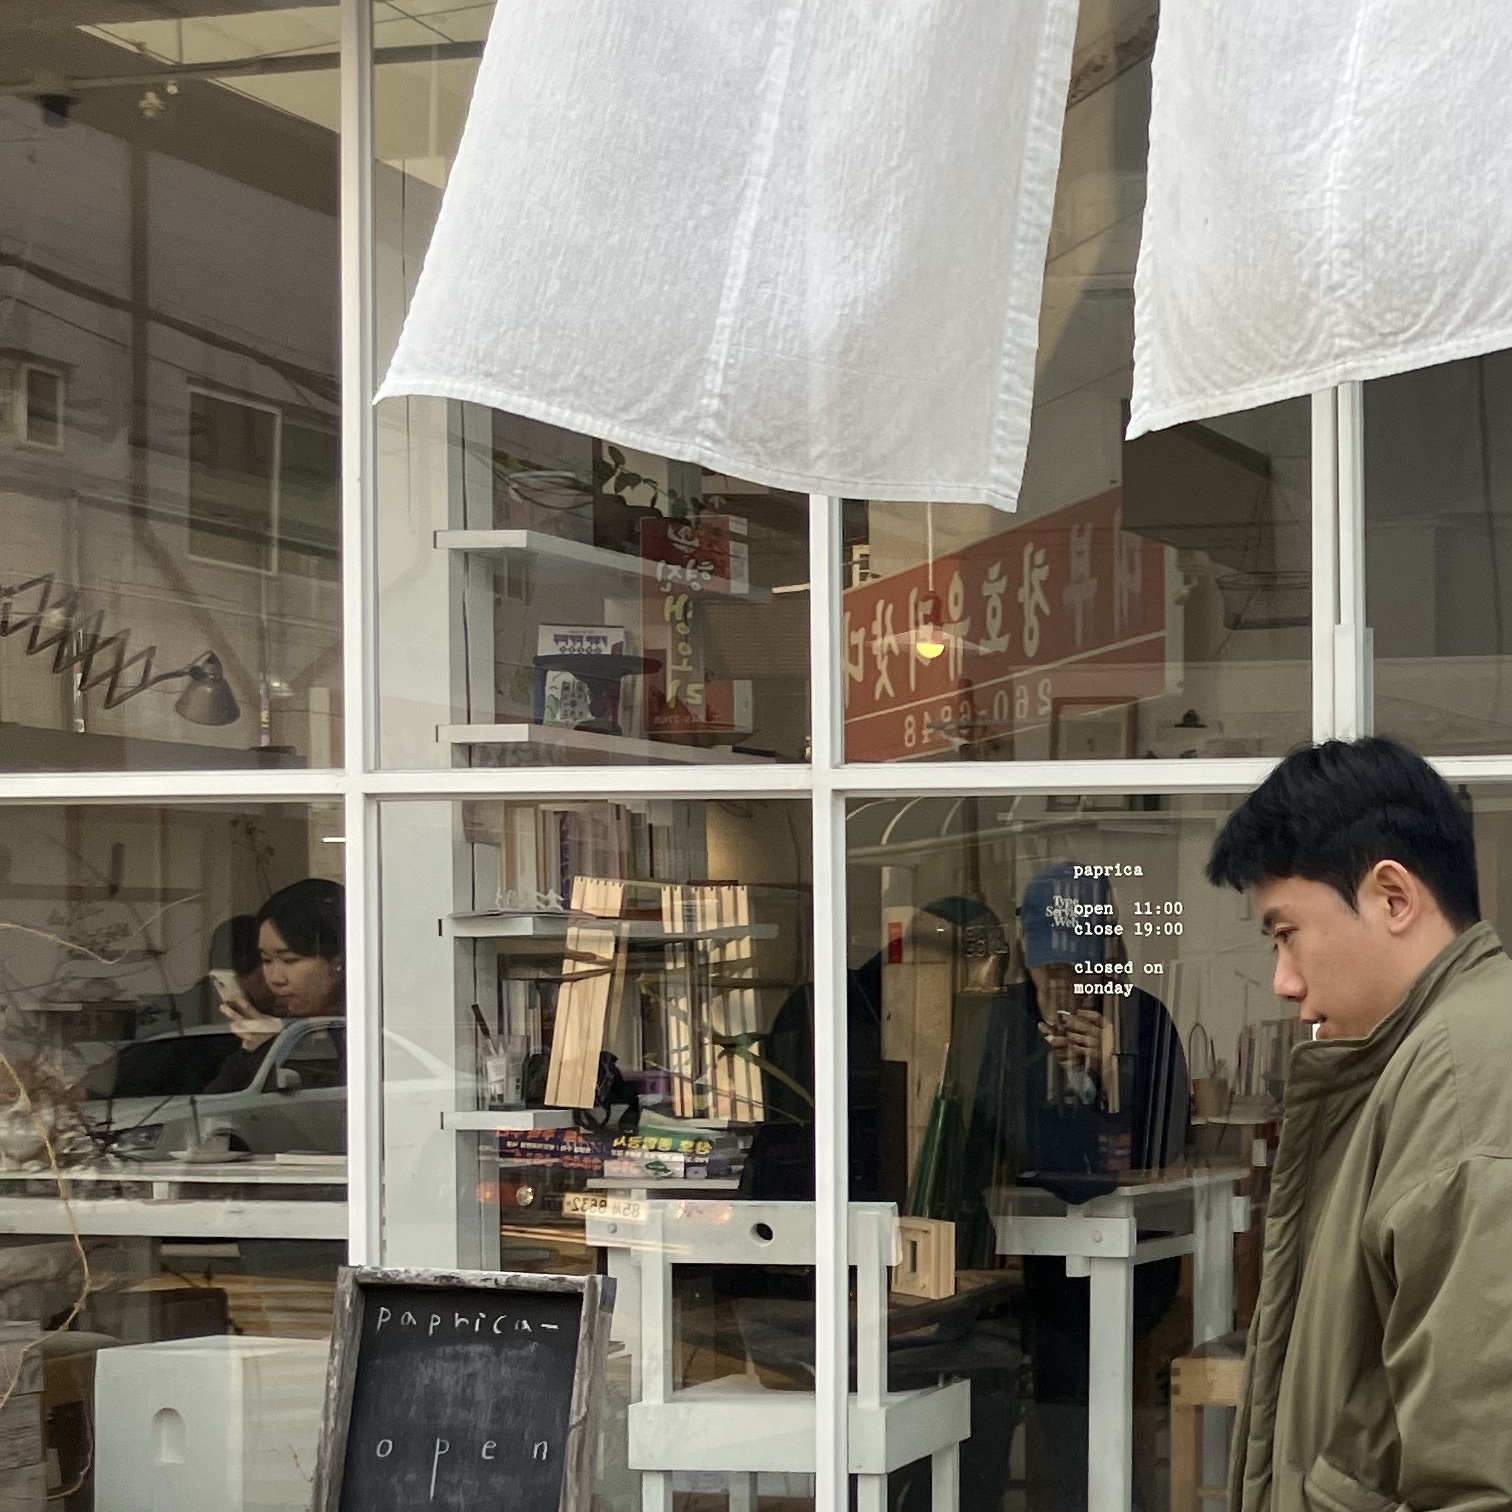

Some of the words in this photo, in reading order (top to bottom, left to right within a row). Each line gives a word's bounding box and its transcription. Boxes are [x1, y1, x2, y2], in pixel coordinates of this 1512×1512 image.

[1073, 863, 1144, 879] paprica
[1073, 903, 1114, 918] open
[1133, 901, 1184, 915] 11:00
[1074, 922, 1124, 936] close
[1133, 922, 1184, 937] 19:00
[1074, 960, 1134, 974] closed
[1143, 962, 1164, 974] on
[1073, 981, 1134, 997] monday
[376, 1437, 549, 1500] open
